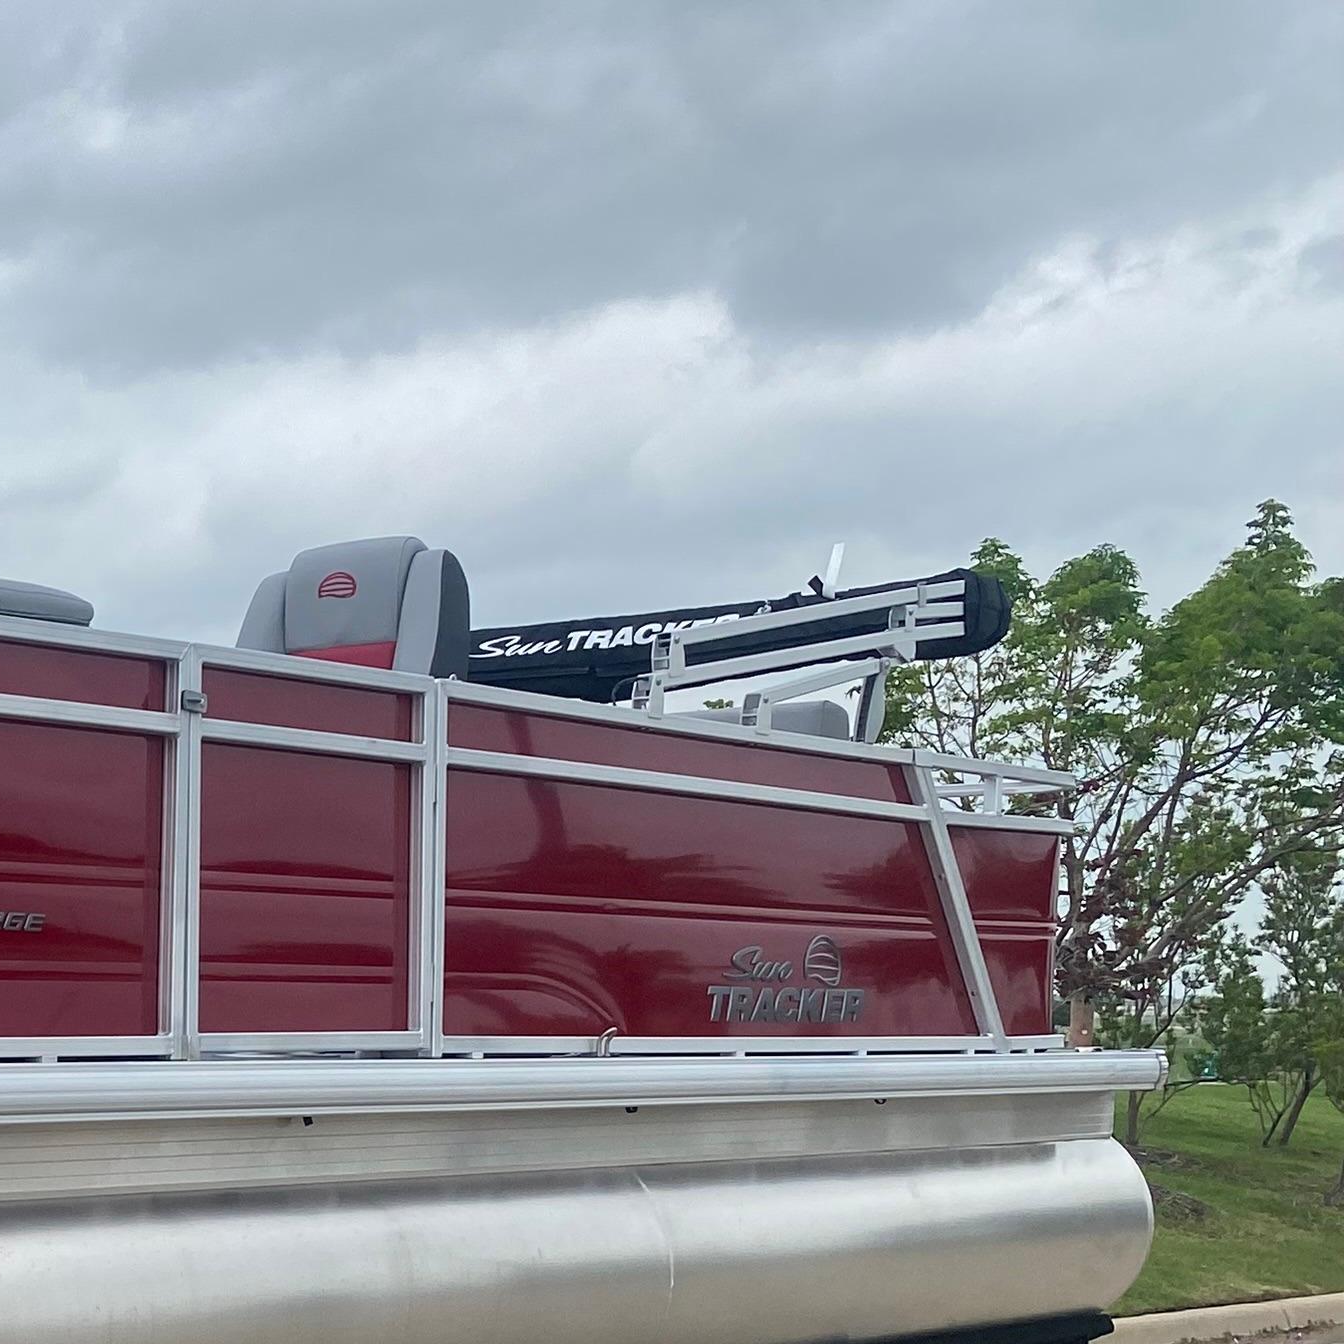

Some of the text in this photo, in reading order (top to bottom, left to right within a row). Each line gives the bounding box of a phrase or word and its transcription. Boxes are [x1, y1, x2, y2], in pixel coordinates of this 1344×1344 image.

[469, 635, 563, 658] Sun
[722, 945, 793, 982] Sun
[707, 985, 866, 1022] TRACKER
